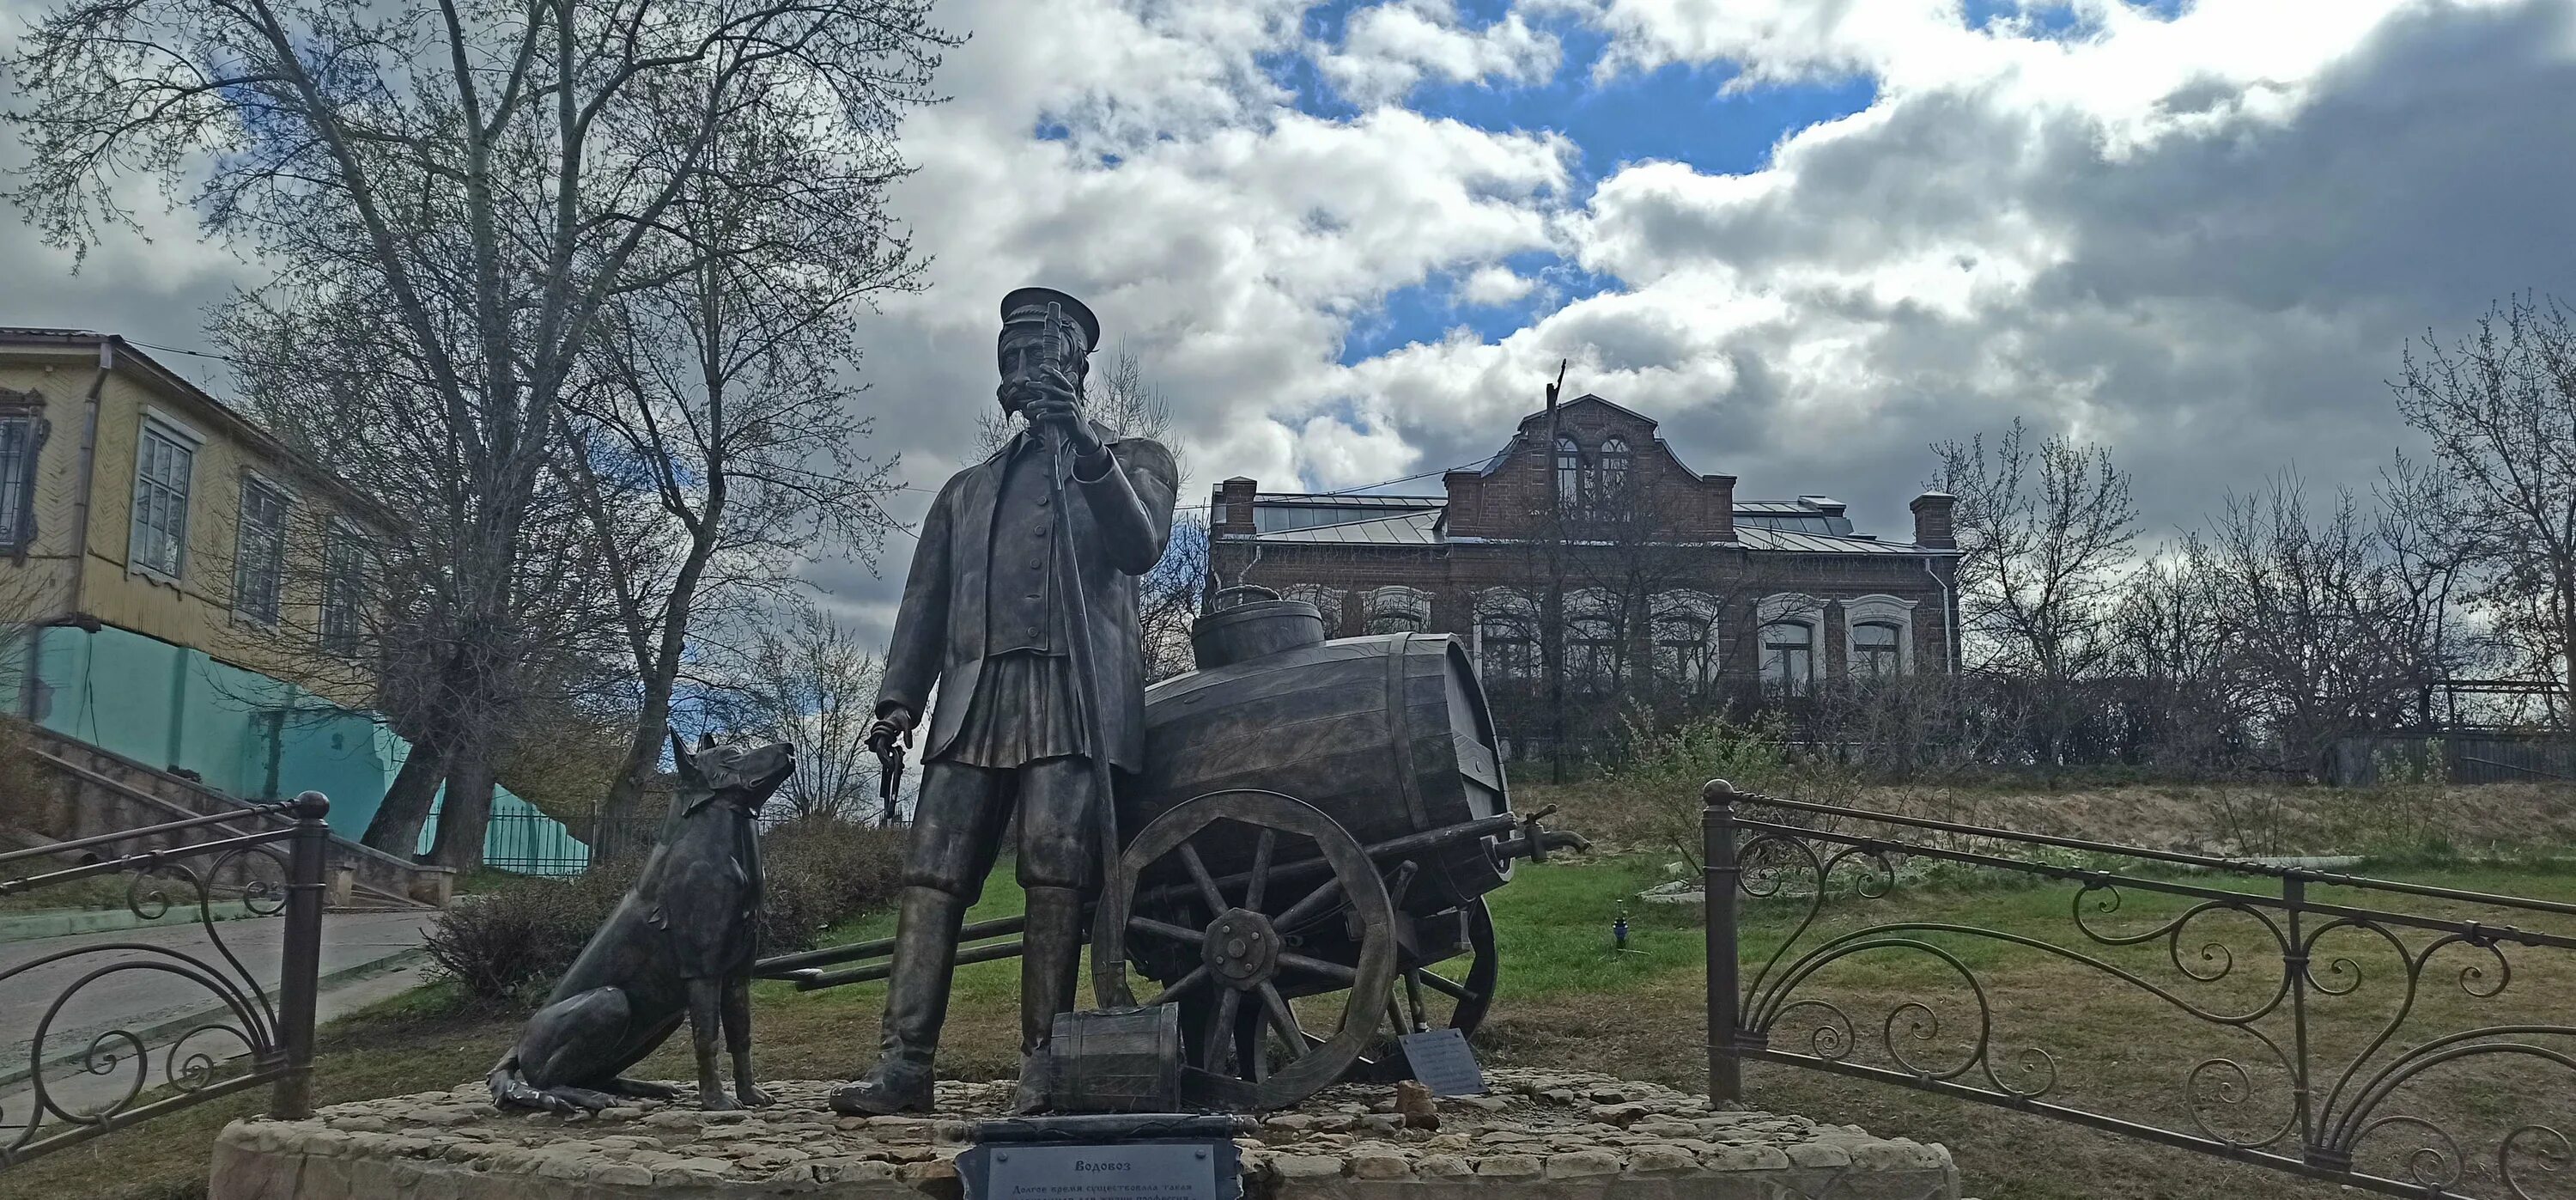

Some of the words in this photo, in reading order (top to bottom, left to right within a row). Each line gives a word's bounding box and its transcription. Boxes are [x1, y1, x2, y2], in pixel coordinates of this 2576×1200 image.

[1075, 1160, 1132, 1173] Водовоз
[1012, 1185, 1047, 1195] Долгое
[1086, 1185, 1157, 1194] существовала
